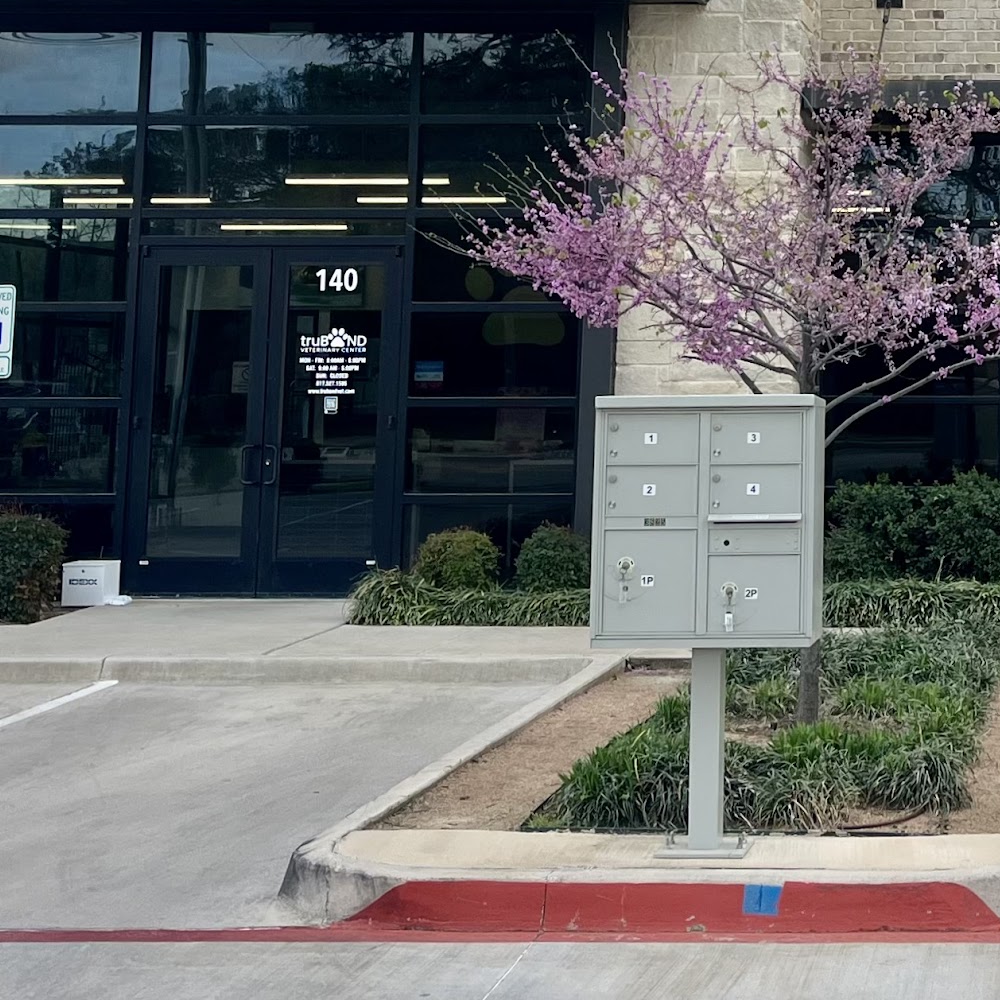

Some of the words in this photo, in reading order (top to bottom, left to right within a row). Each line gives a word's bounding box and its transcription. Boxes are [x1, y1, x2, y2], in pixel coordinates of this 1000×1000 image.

[315, 268, 359, 292] 140
[750, 434, 757, 442] 3
[646, 486, 653, 494] 2
[750, 485, 757, 493] 4
[641, 577, 654, 585] 1P
[745, 590, 758, 598] 2P
